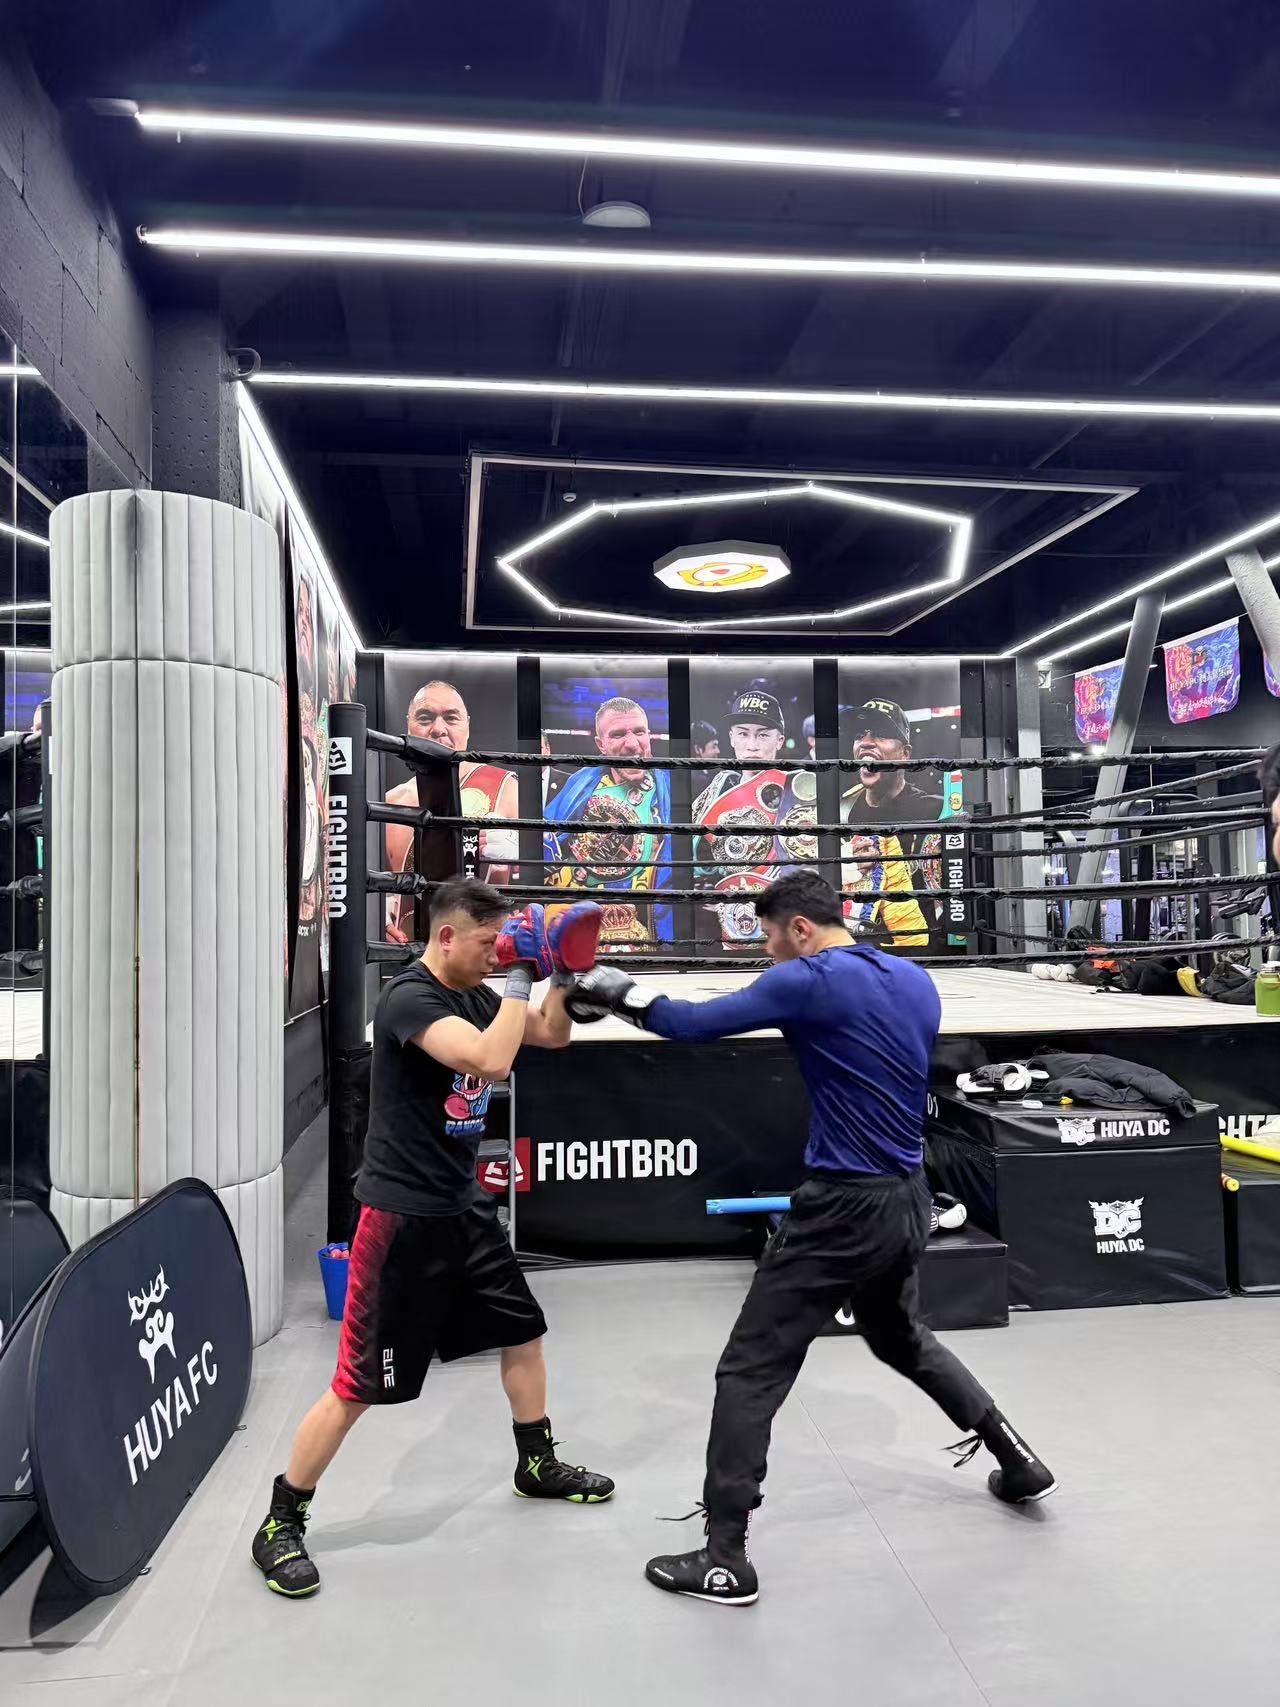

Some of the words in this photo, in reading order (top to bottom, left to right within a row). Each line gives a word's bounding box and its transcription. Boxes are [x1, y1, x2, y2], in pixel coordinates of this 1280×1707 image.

[739, 697, 770, 711] WBC
[948, 858, 965, 922] FIGHBRO
[1101, 1120, 1146, 1138] HUYA
[1147, 1119, 1171, 1136] DC
[537, 1138, 698, 1182] FIGHTBRO
[1096, 1240, 1129, 1254] HUYA
[1128, 1238, 1145, 1251] DC
[123, 1375, 193, 1486] HUYA
[186, 1340, 218, 1406] FC
